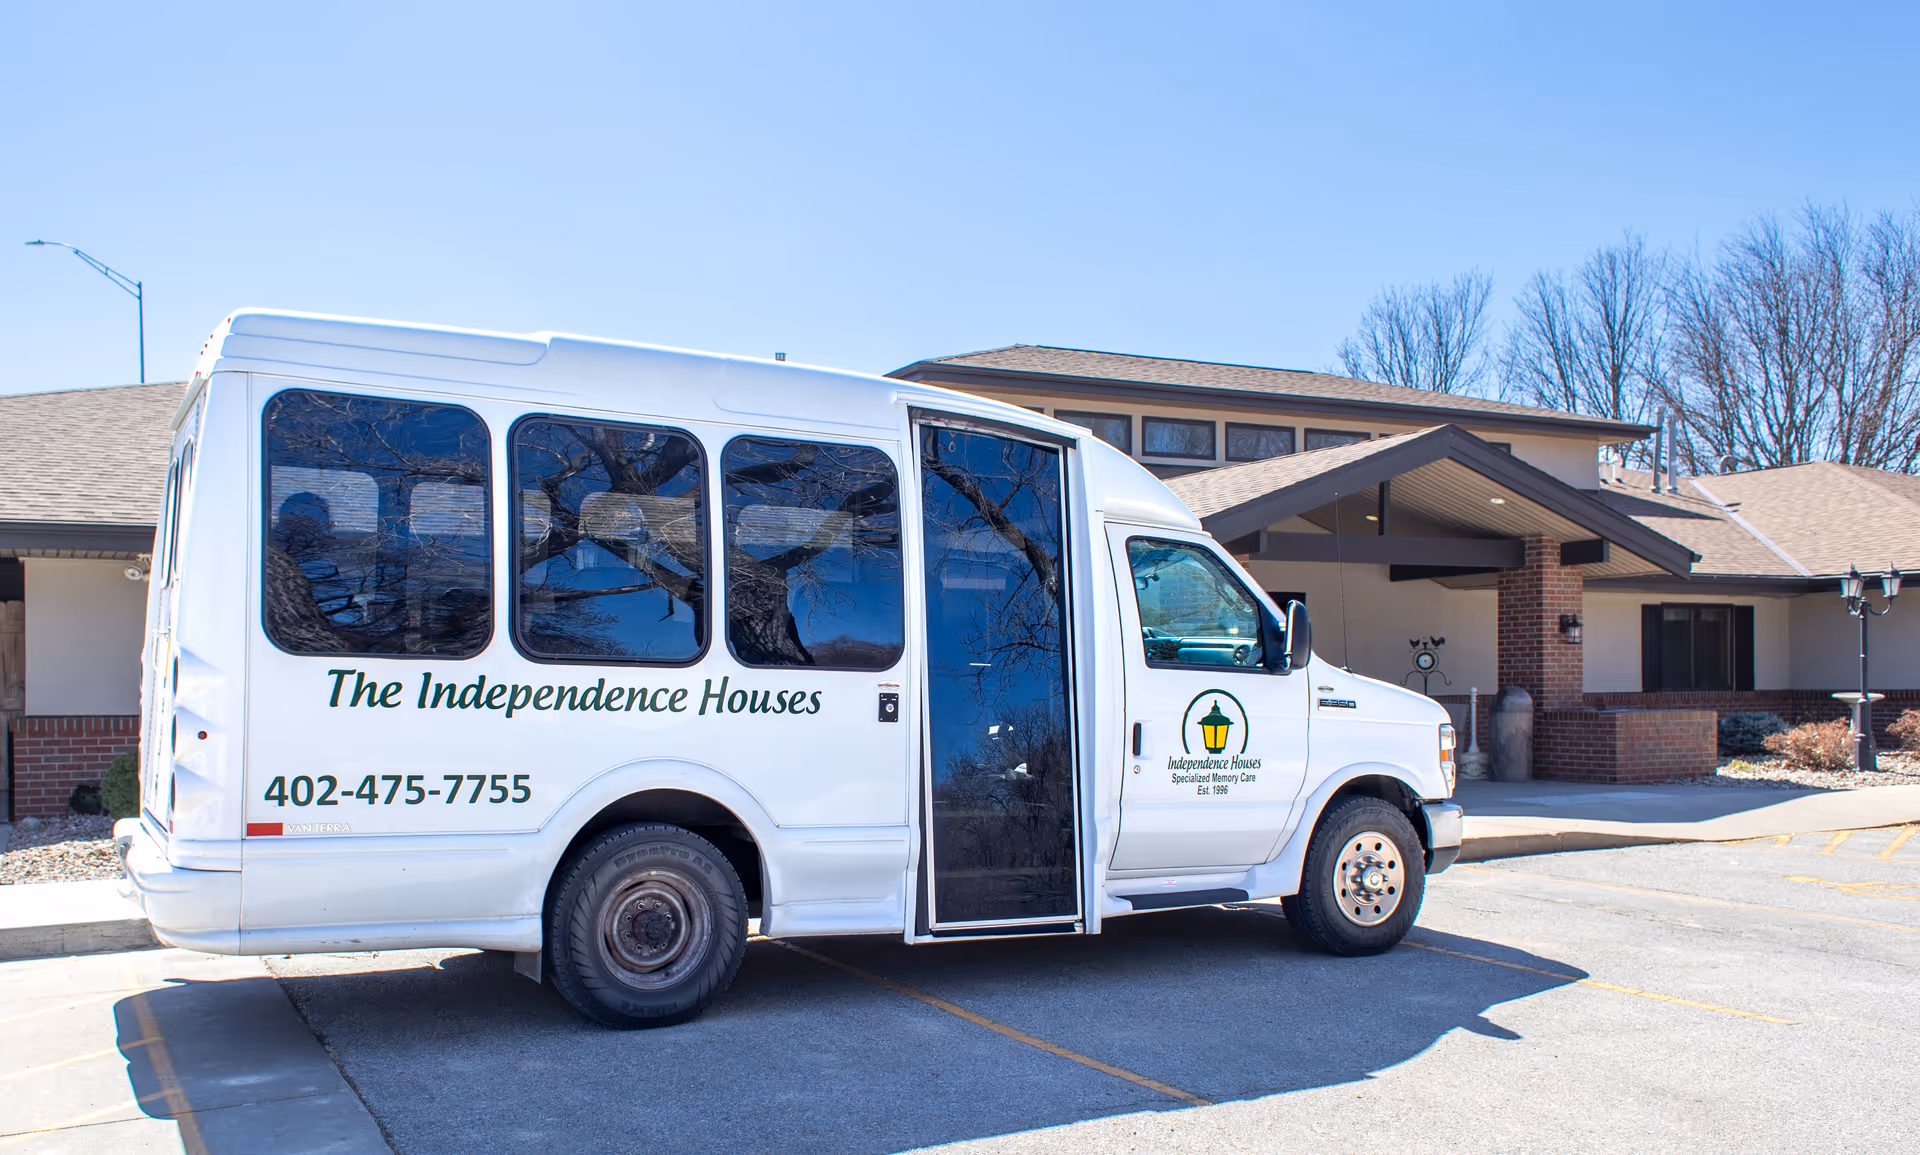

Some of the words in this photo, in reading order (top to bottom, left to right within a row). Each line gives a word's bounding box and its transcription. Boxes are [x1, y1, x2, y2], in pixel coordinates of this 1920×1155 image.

[327, 668, 403, 709] The
[417, 671, 688, 719] Independence
[698, 675, 823, 716] Houses
[1167, 756, 1228, 772] Independence
[1230, 754, 1261, 770] Houses
[1171, 772, 1210, 784] Specialized
[1211, 772, 1239, 785] Memory
[1240, 772, 1256, 783] Care
[264, 774, 532, 807] 402-475-7755
[1197, 785, 1211, 795] Est.
[1212, 785, 1229, 795] 1996
